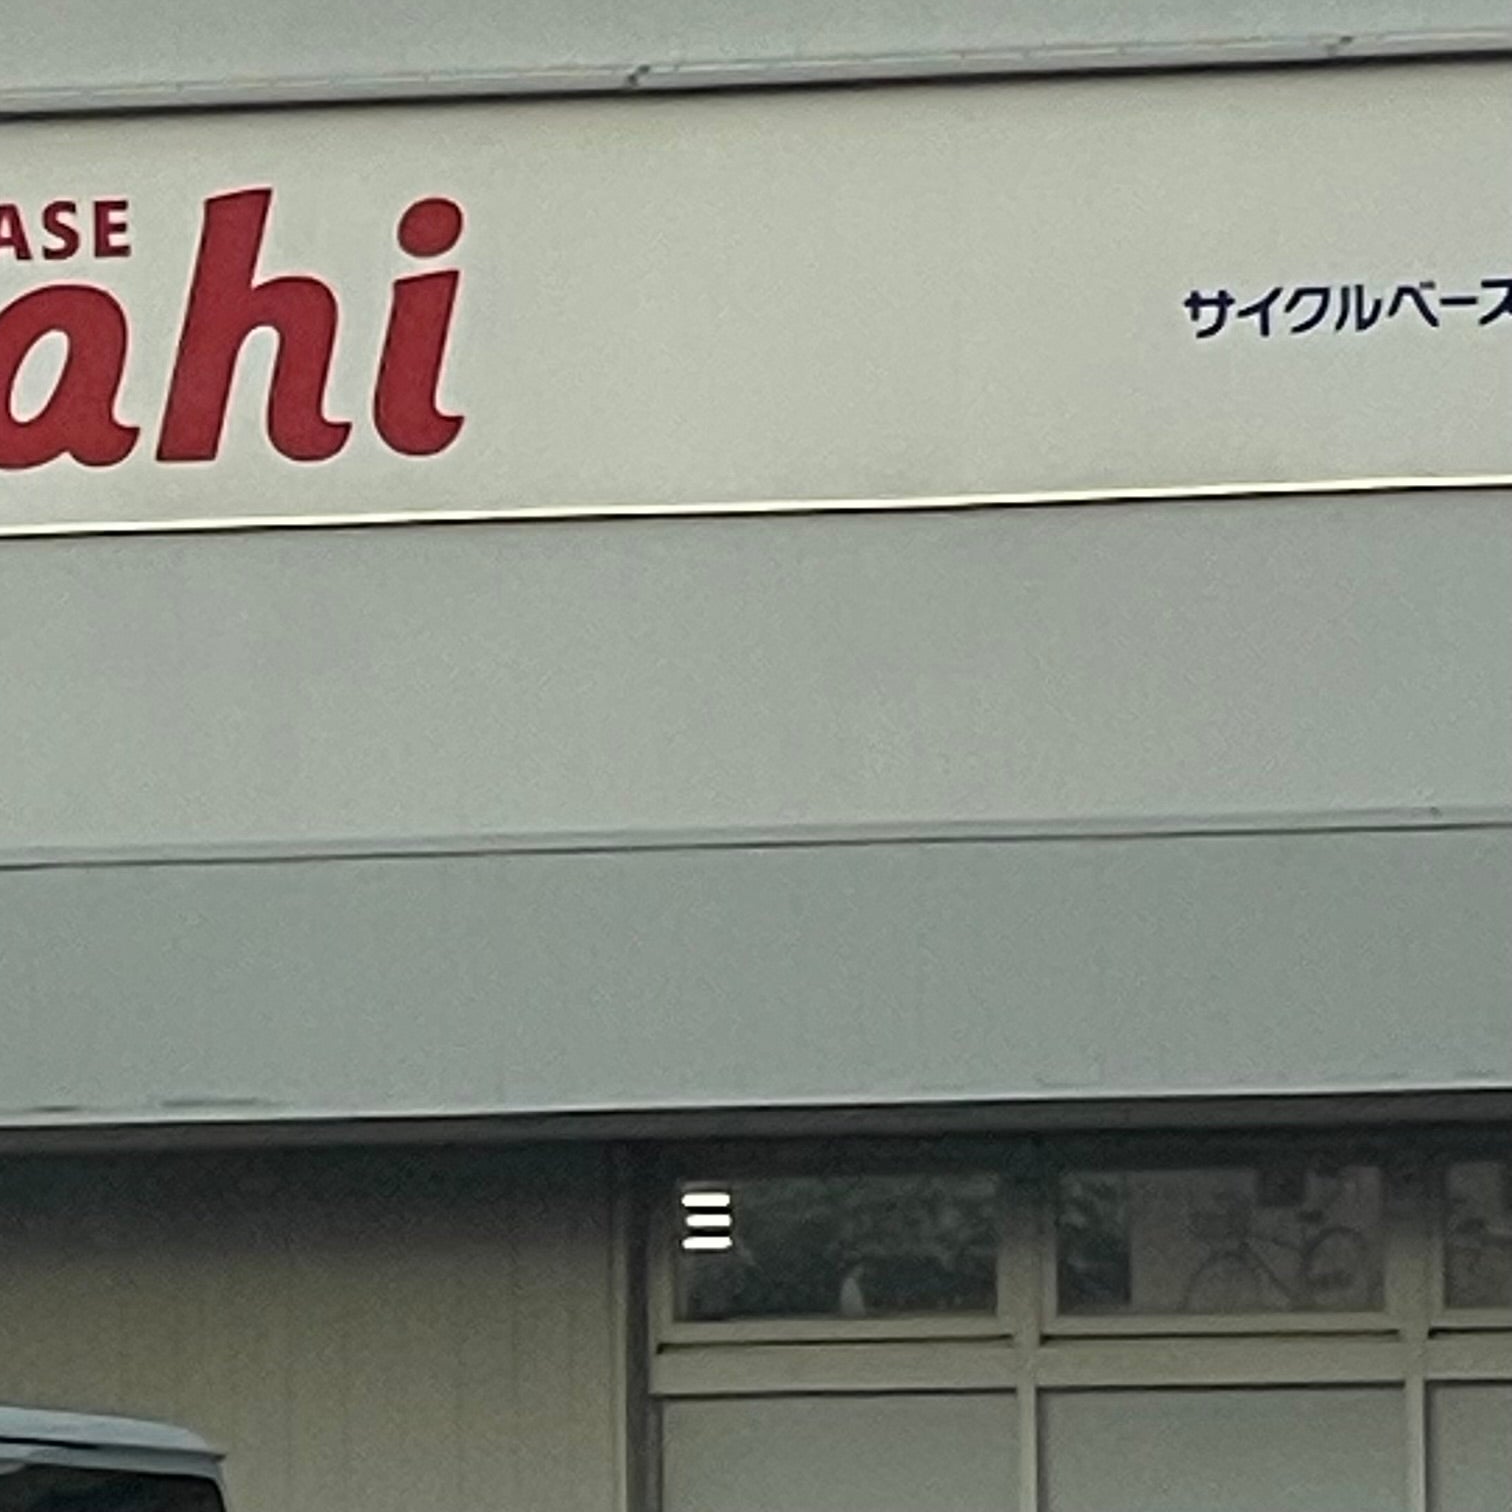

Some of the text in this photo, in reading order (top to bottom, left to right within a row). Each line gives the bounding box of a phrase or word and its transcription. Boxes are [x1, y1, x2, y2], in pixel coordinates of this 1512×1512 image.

[1184, 280, 1512, 338] サイクルベース
